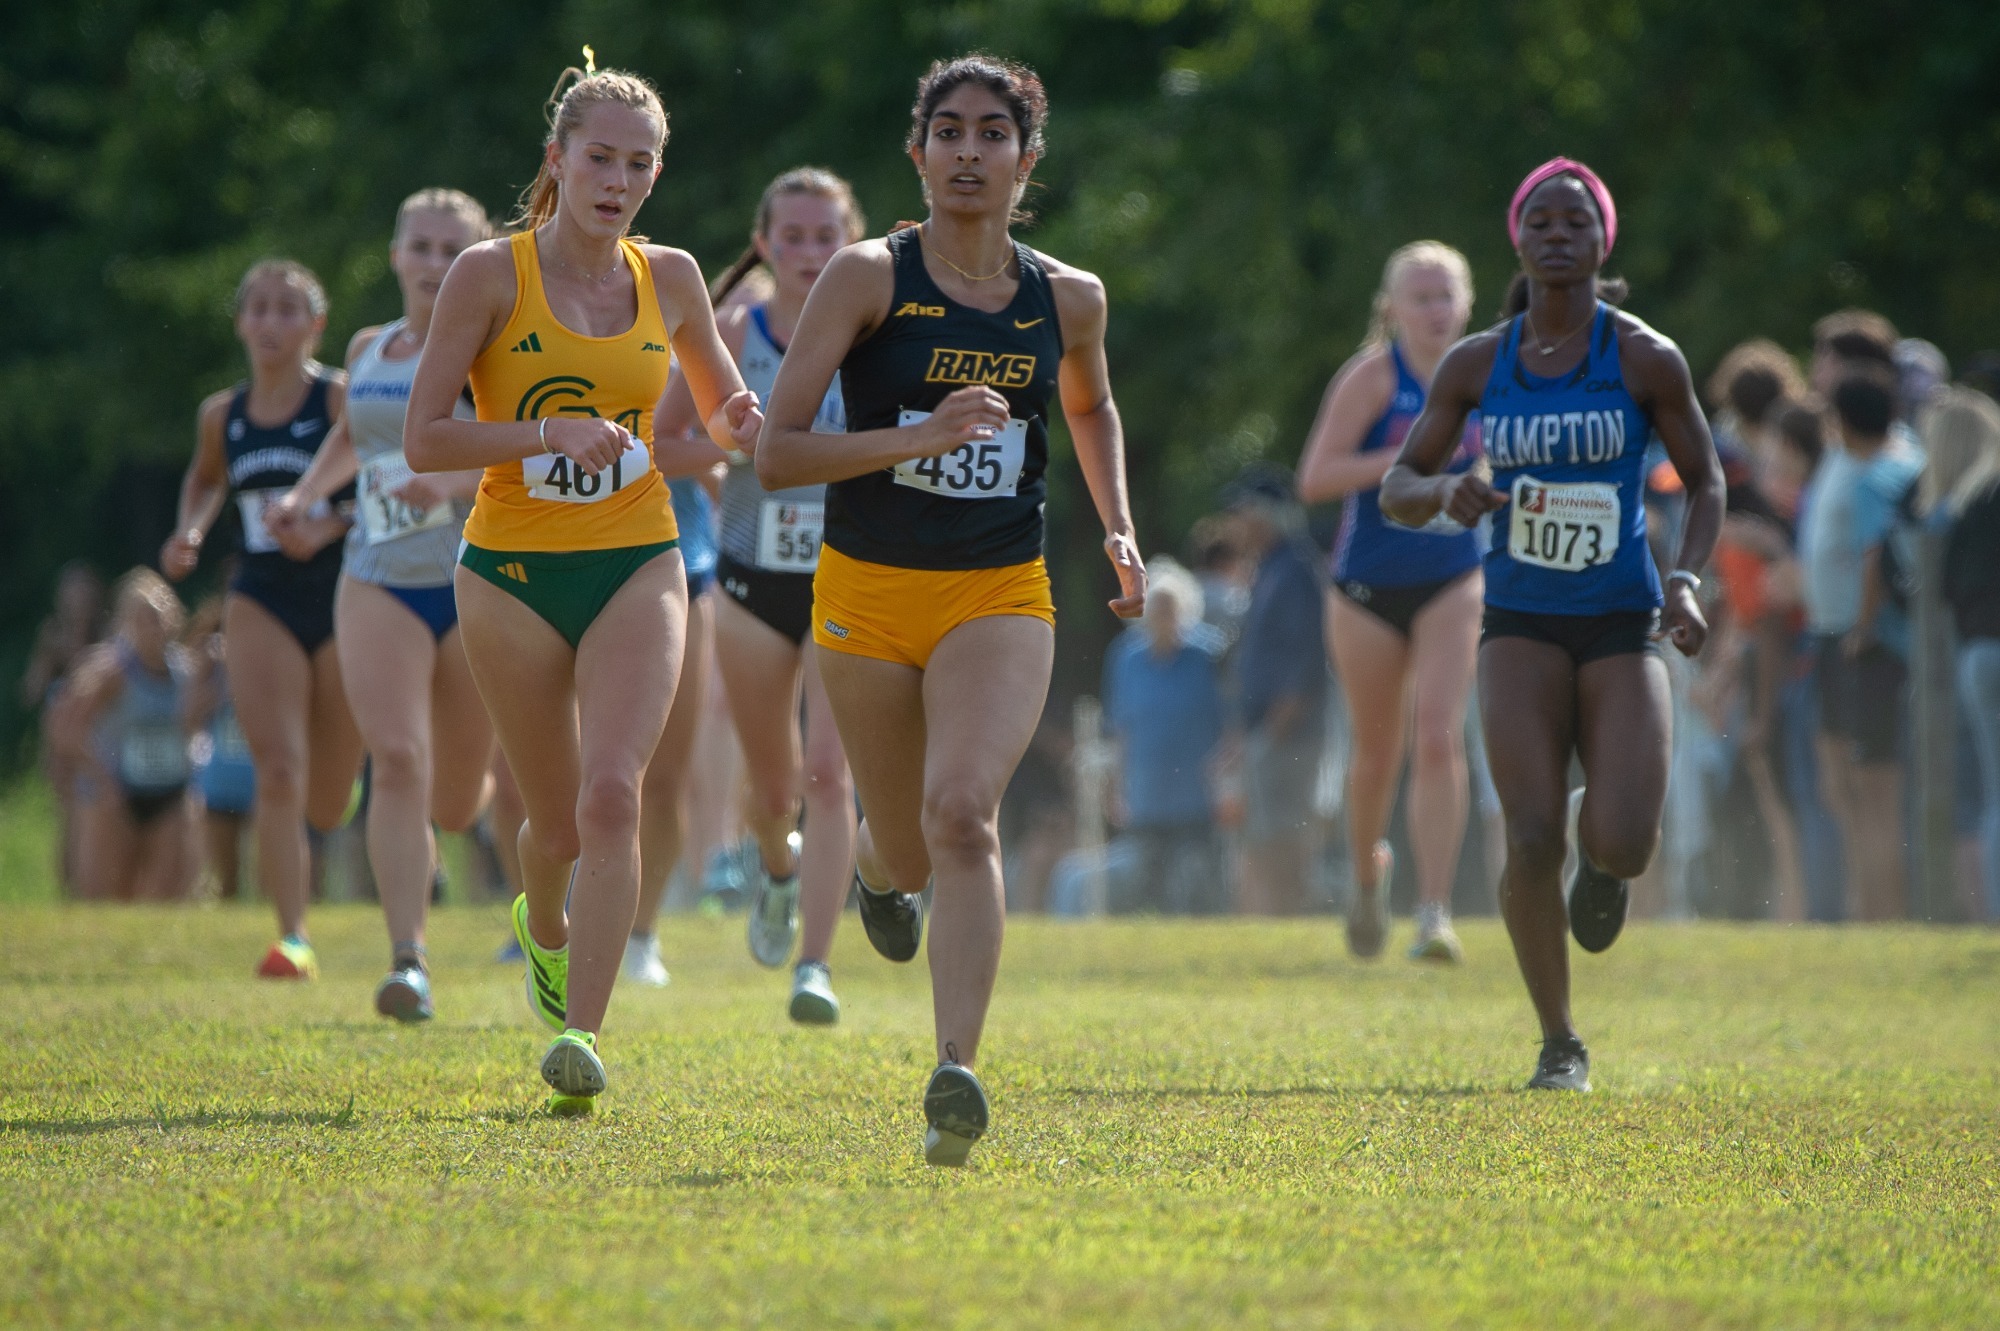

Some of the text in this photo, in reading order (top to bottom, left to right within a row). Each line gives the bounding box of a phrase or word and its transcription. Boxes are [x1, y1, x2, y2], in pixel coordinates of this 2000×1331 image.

[894, 302, 946, 317] A10
[925, 348, 1036, 388] RAMS
[1482, 409, 1626, 468] HAMPTON
[544, 455, 623, 497] 461
[914, 442, 1004, 491] 435
[1550, 497, 1614, 511] RUNNING
[777, 529, 824, 561] 55
[1523, 518, 1603, 565] 1073
[824, 619, 850, 640] RAMS
